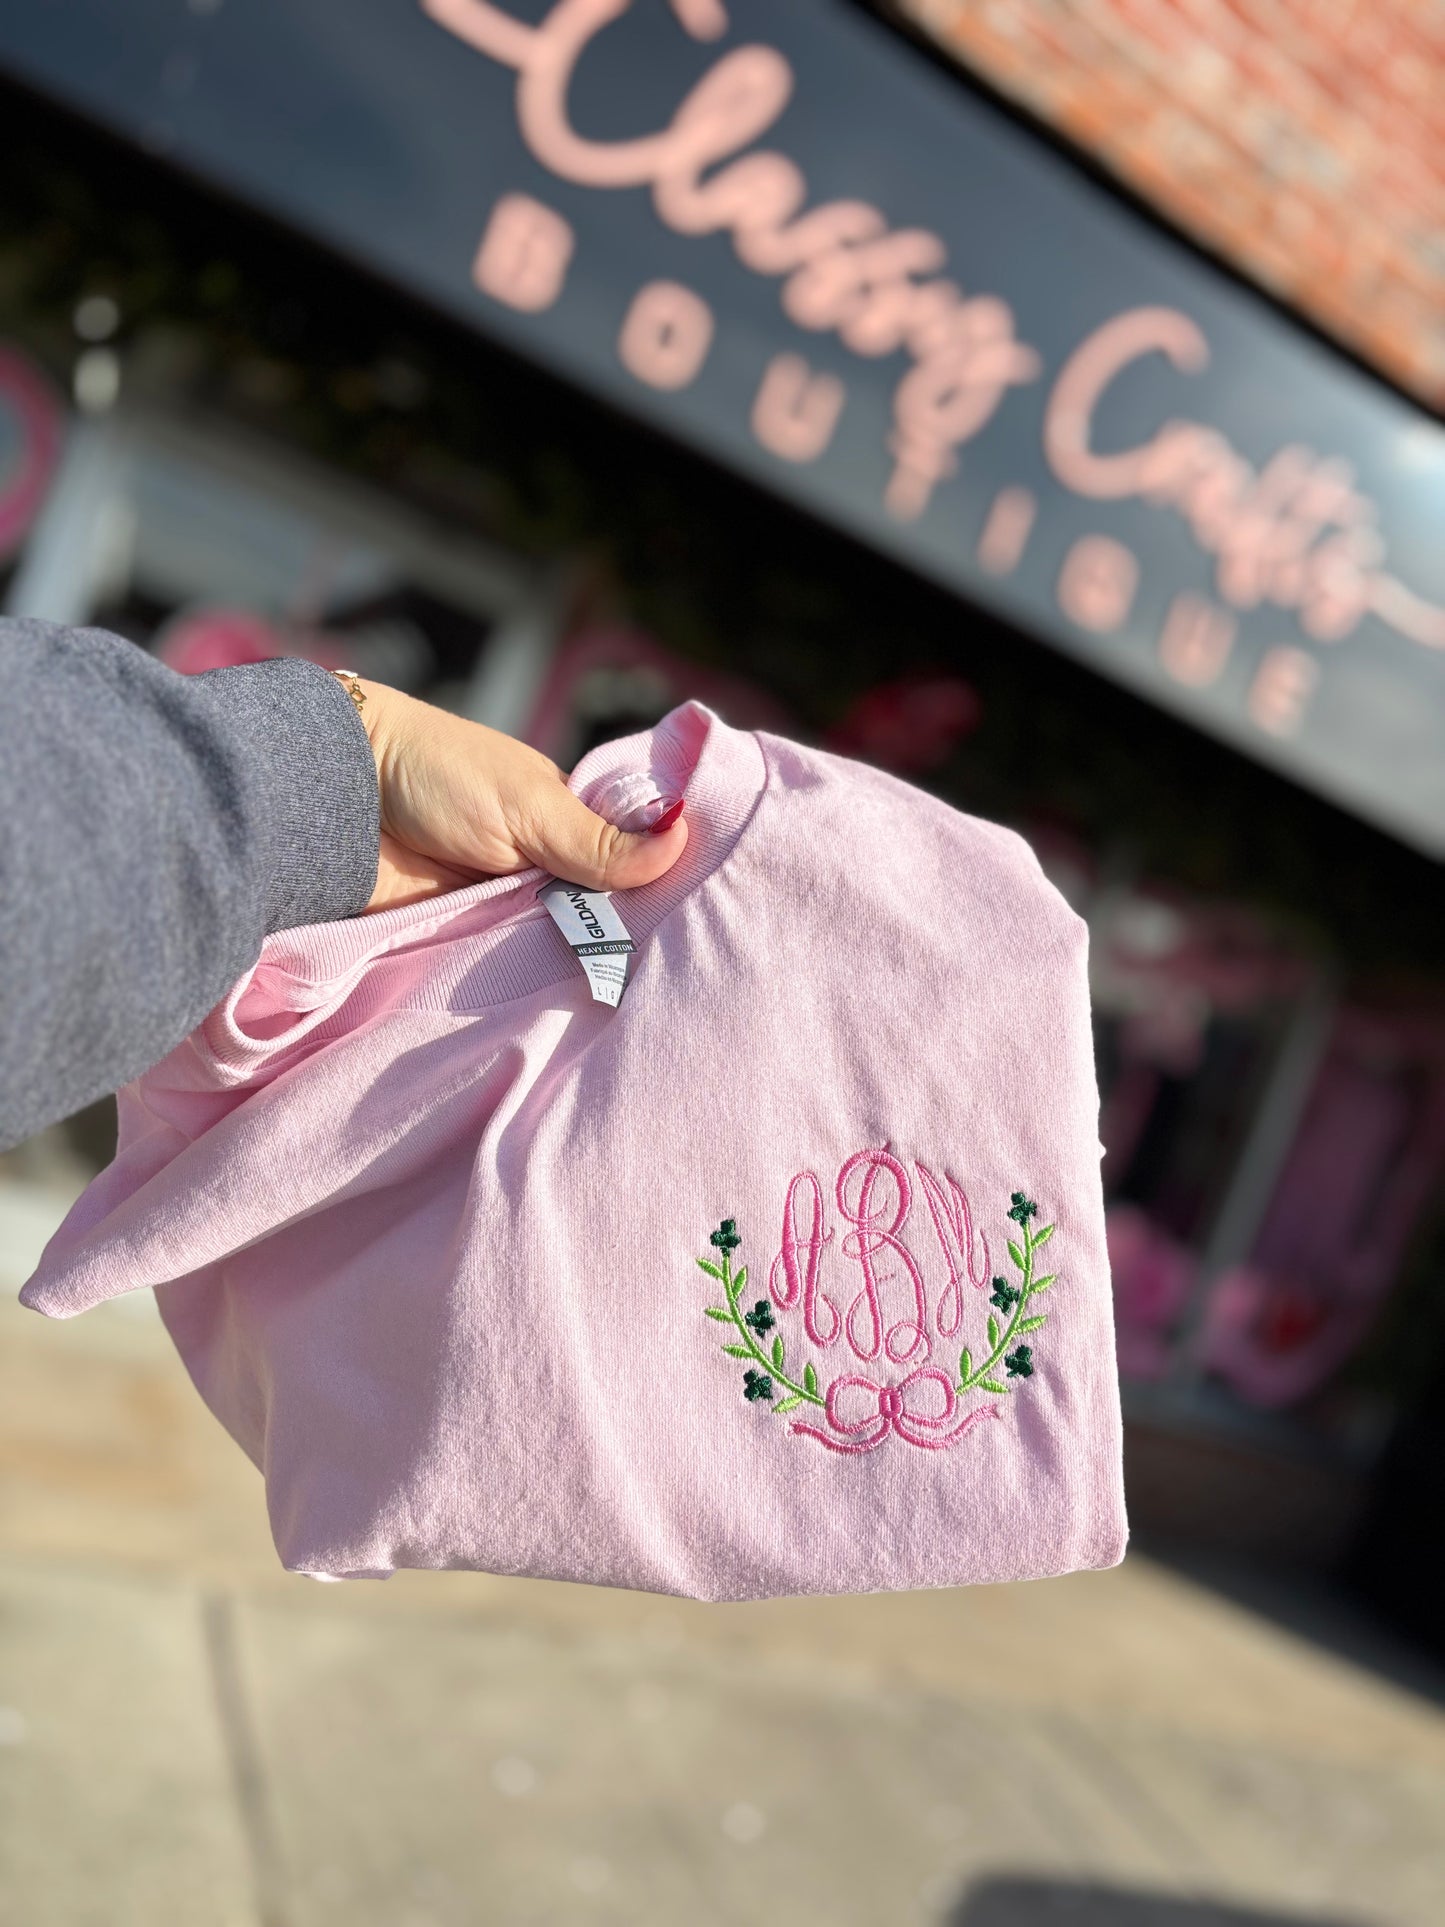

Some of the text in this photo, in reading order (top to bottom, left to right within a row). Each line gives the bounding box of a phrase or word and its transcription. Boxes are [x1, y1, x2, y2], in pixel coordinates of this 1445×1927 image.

[474, 196, 1320, 737] BOUTIQUE
[567, 891, 606, 939] GILDAN
[577, 944, 634, 955] HEAVY COTTON
